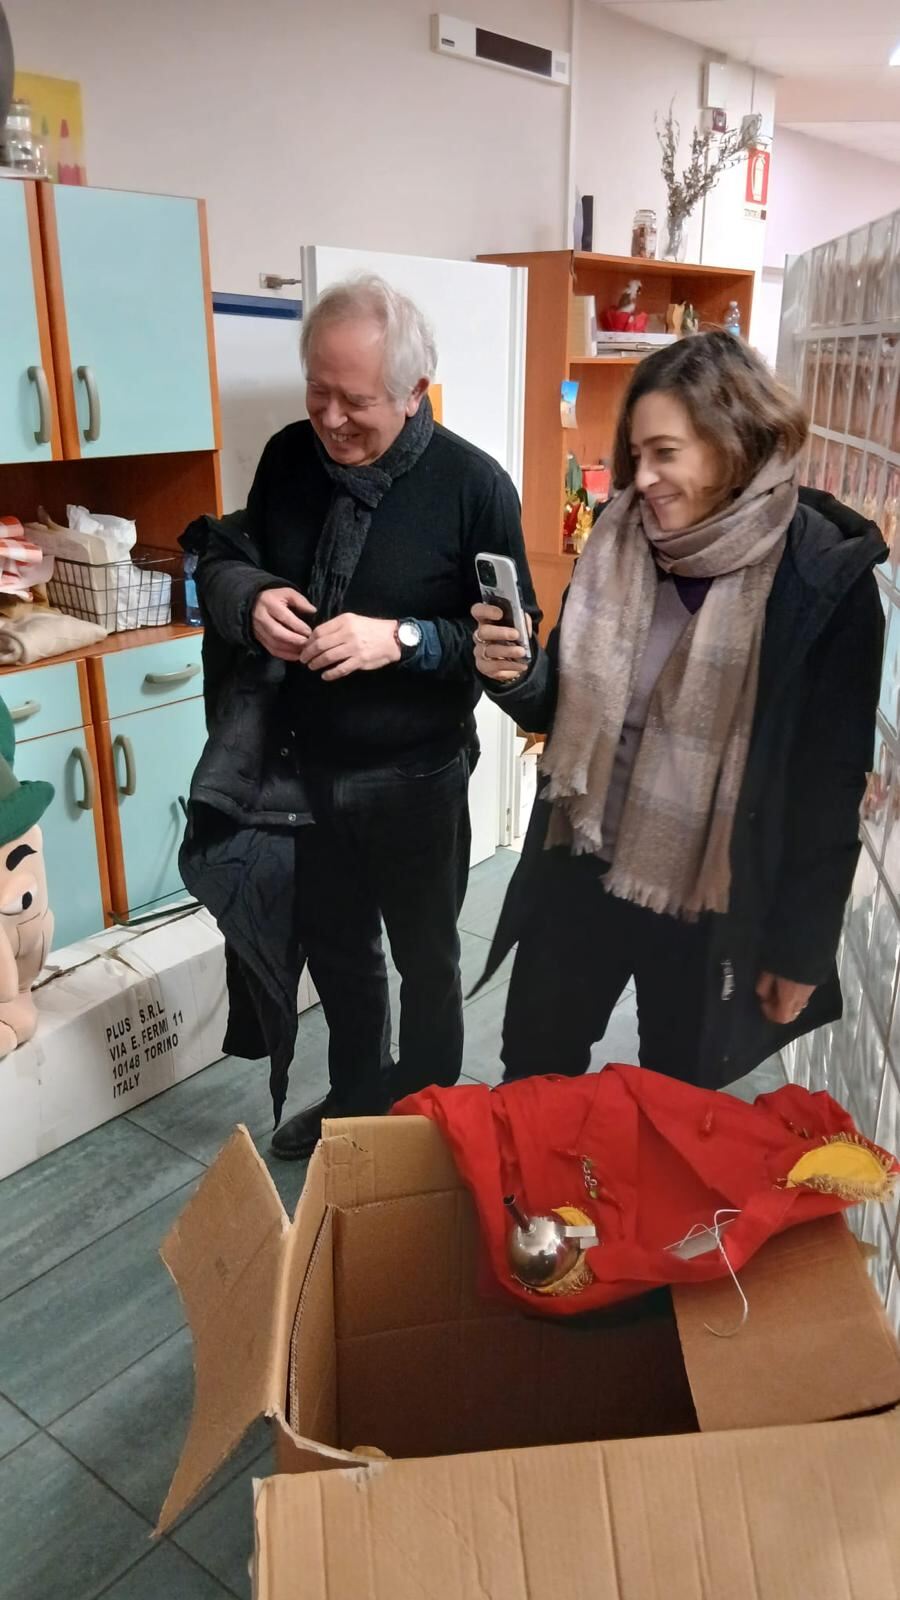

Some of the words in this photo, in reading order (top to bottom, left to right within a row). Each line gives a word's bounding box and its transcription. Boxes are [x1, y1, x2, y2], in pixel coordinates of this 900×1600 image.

[106, 1018, 131, 1042] PLUS
[110, 1042, 127, 1062] VIA
[173, 1010, 184, 1026] 11
[113, 1054, 140, 1079] 10148
[145, 1033, 179, 1062] TORINO
[113, 1073, 140, 1099] ITALY
